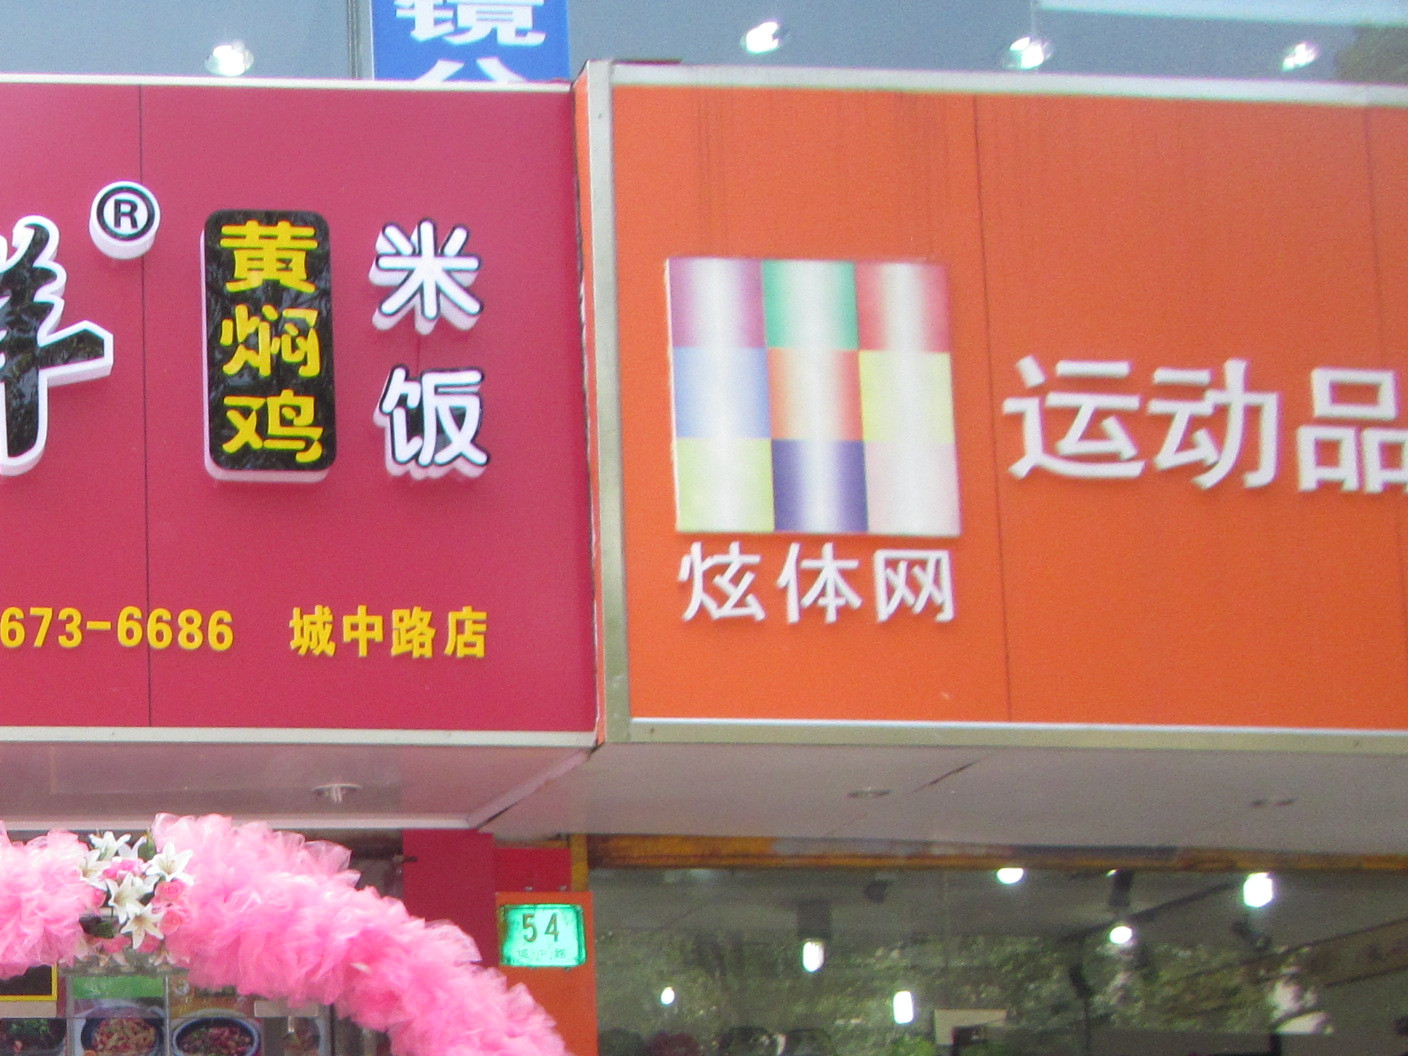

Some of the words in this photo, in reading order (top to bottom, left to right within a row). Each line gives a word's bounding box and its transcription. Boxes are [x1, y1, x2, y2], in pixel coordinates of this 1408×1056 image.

[218, 219, 324, 464] 黄焖鸡
[372, 219, 490, 472] 米饭
[1002, 355, 1408, 494] 运动品
[289, 604, 488, 658] 城中路店
[678, 542, 956, 624] 炫体网
[522, 911, 560, 942] 54
